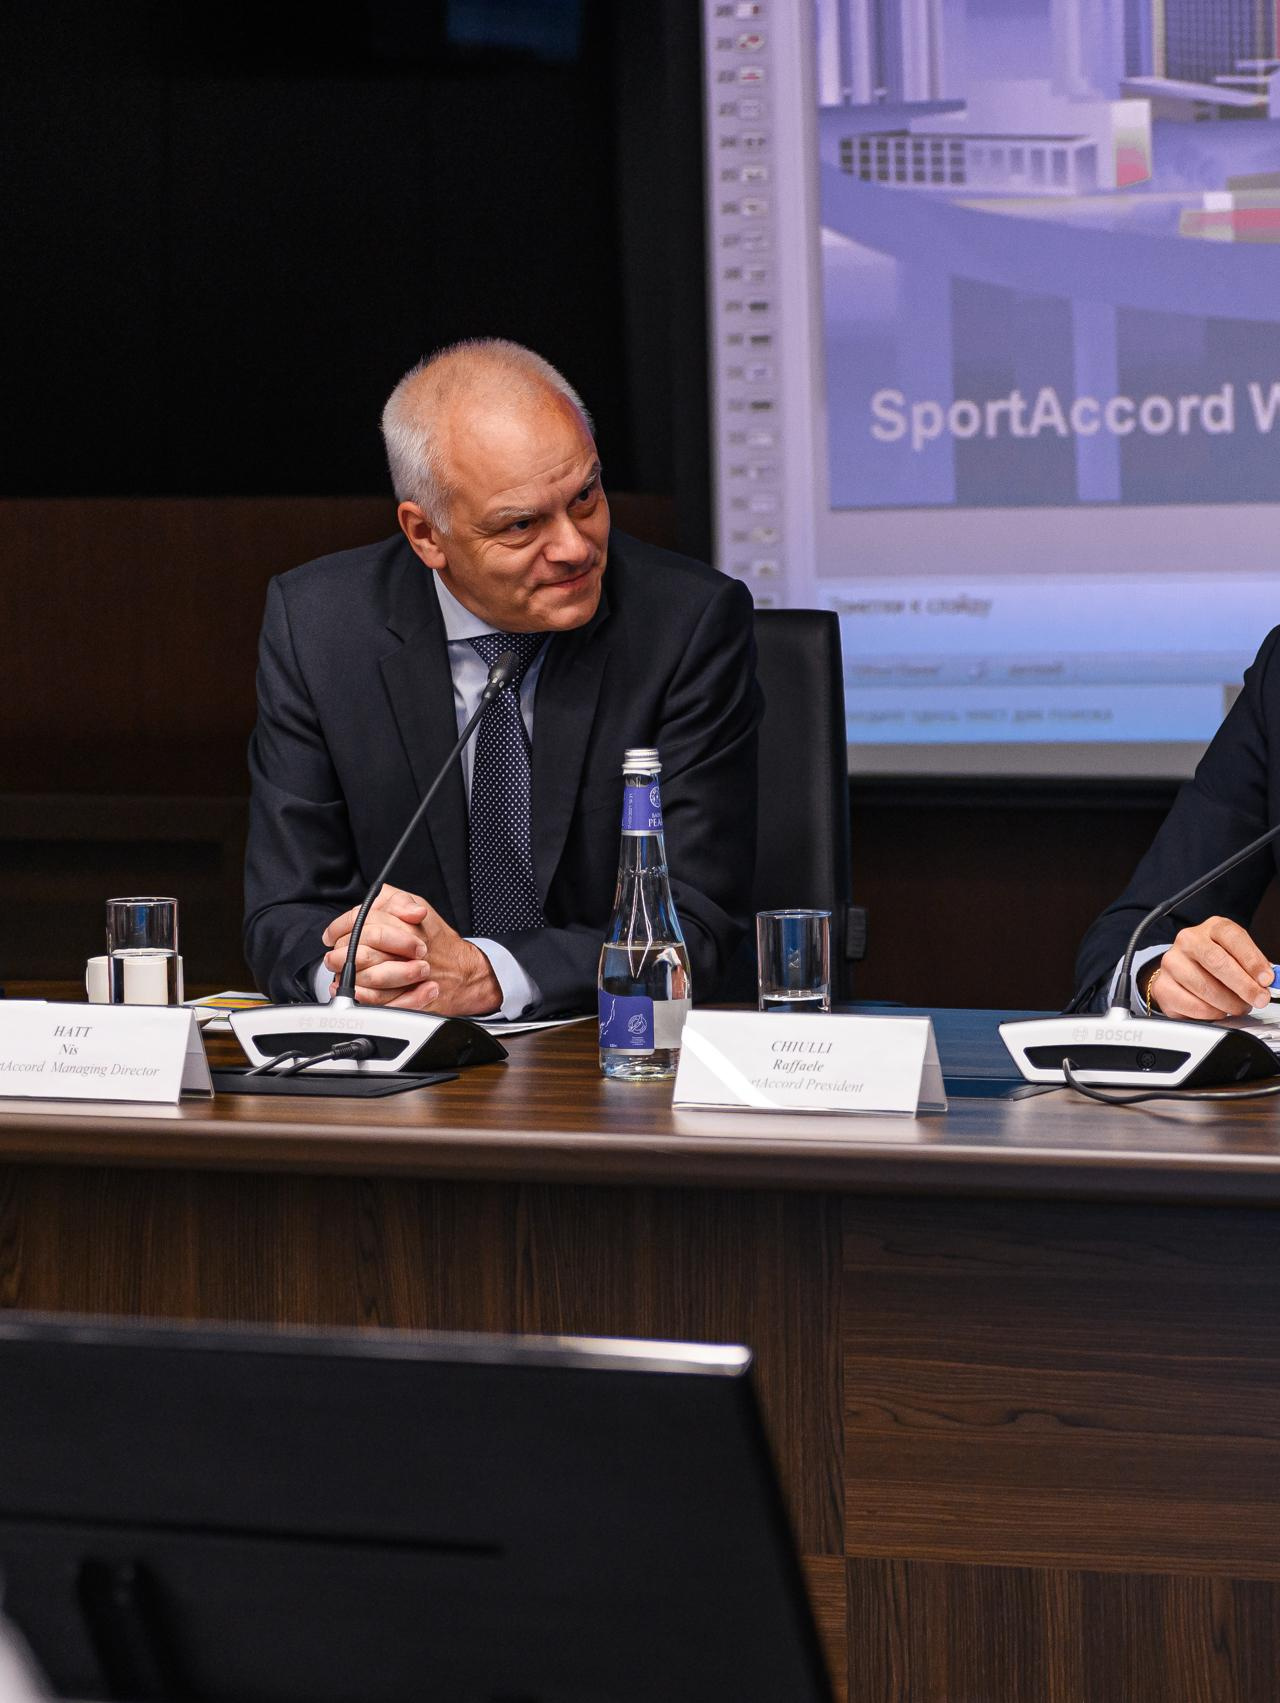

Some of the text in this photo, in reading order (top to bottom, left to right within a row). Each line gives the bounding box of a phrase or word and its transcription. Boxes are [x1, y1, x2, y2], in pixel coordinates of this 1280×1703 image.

[870, 383, 1235, 451] SportAccord
[319, 1017, 365, 1030] BOSCH
[53, 1025, 92, 1038] HATT
[1095, 1028, 1143, 1041] BOSCH
[58, 1043, 78, 1055] Nis
[51, 1061, 108, 1077] Managing
[110, 1063, 160, 1077] Director
[773, 1058, 824, 1074] Raffaele
[751, 1077, 864, 1093] rtAccord President
